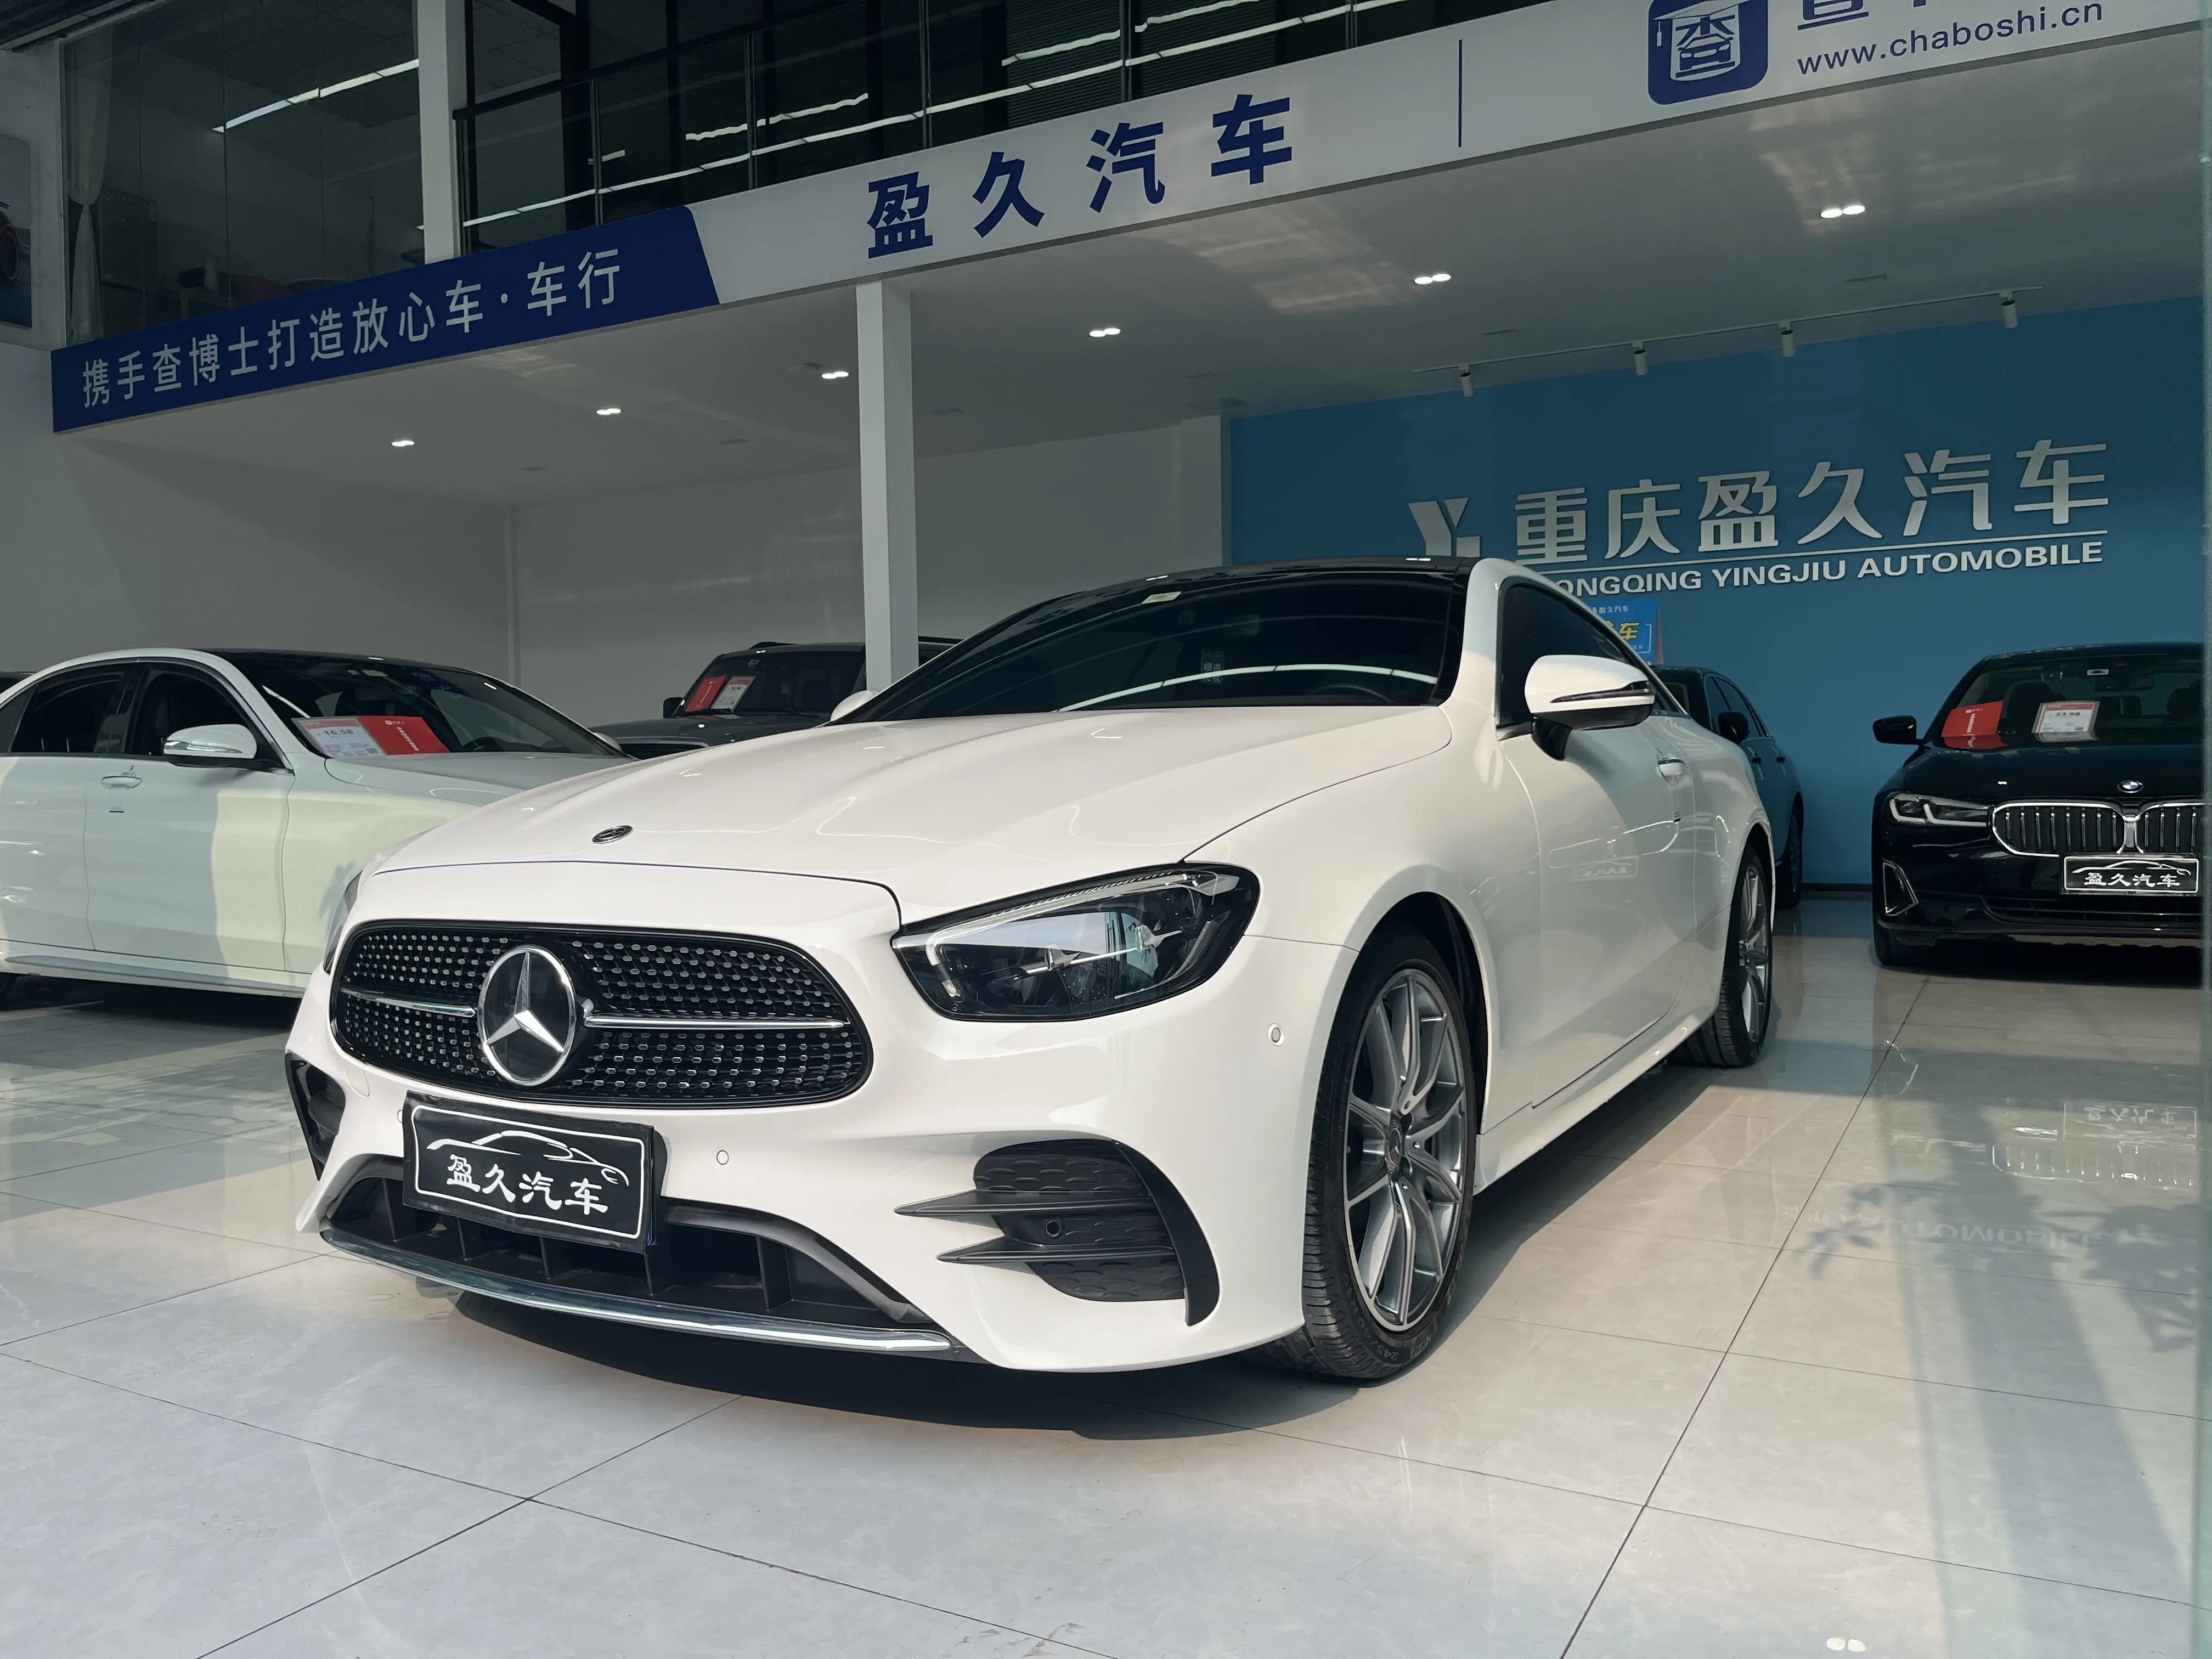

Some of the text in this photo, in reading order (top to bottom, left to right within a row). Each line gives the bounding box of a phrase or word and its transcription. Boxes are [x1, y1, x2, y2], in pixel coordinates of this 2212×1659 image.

[1797, 3, 2102, 75] www.chaboshi.cn
[867, 93, 1293, 259] 盈久汽车
[82, 247, 620, 409] 携手查博士打造放心车·车行
[1515, 439, 2108, 562] 重庆盈久汽车
[1554, 541, 2103, 597] ONGQING YINGJIU AUTOMOBILE
[2084, 872, 2180, 888] 盈久汽车
[447, 1153, 608, 1215] 盈久汽车
